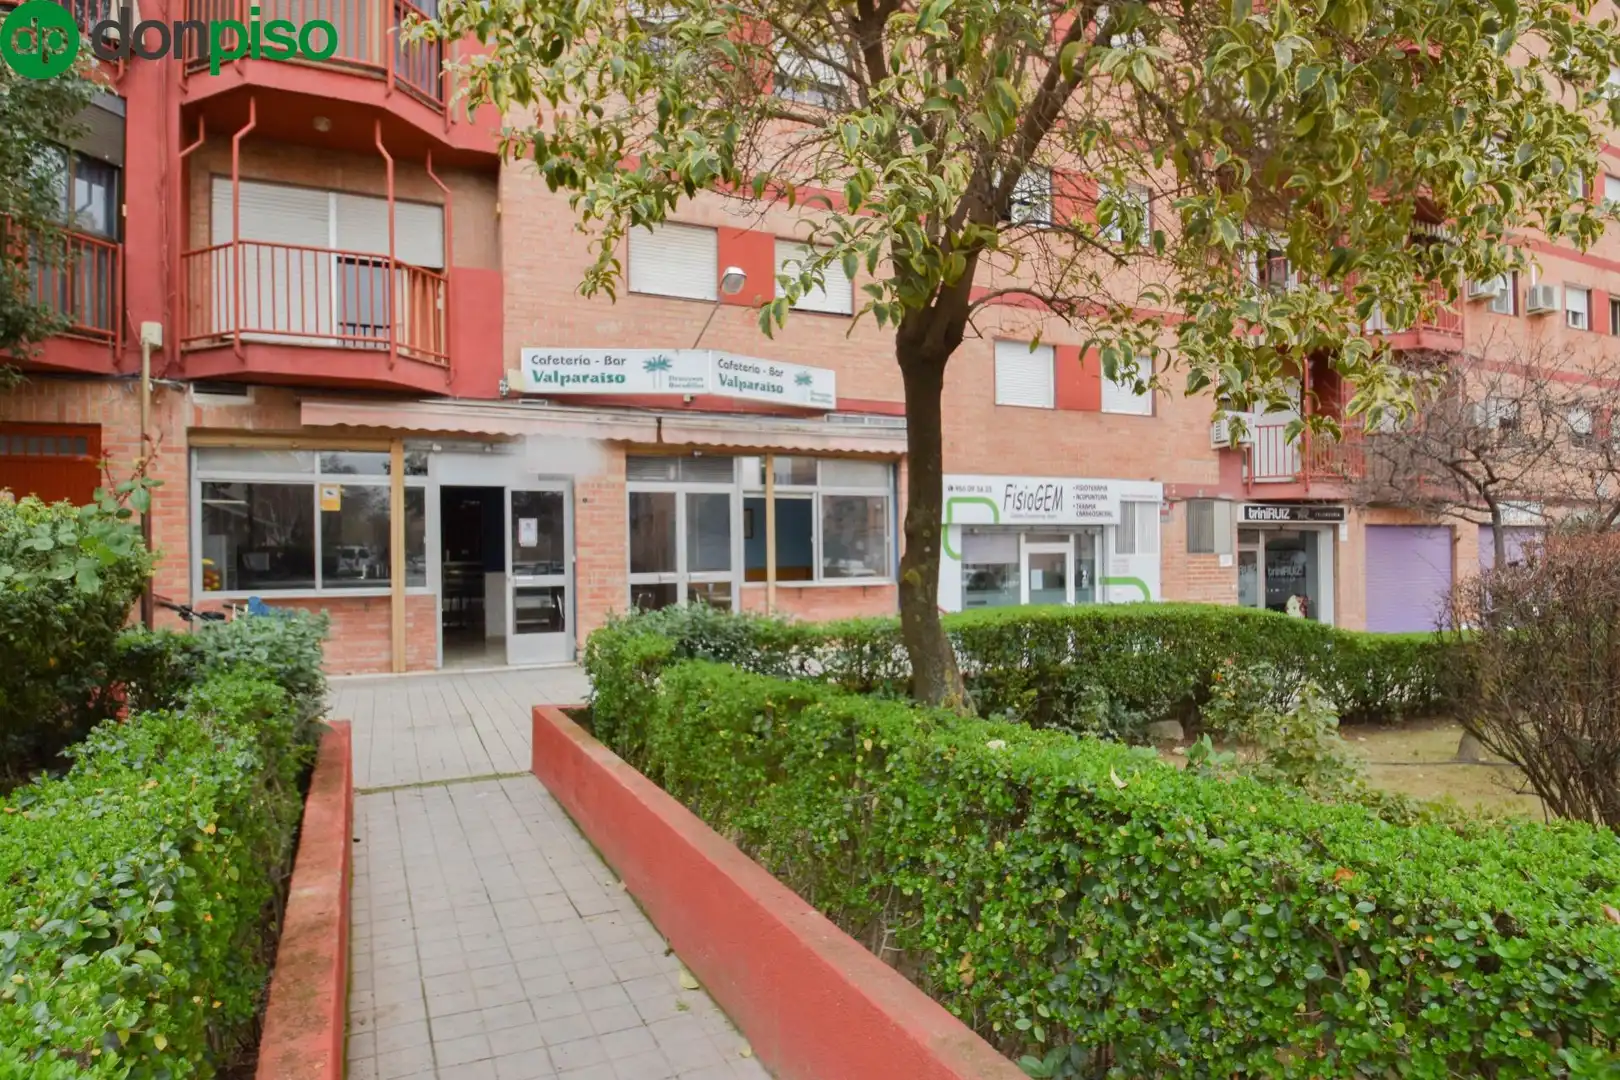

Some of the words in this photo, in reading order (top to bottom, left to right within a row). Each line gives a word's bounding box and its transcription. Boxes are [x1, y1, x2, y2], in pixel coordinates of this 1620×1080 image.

[604, 355, 627, 366] Bar
[531, 370, 626, 386] Valparaiso
[768, 367, 784, 378] Bar
[718, 373, 784, 394] Valparaiso
[1003, 484, 1063, 511] FisioGEM
